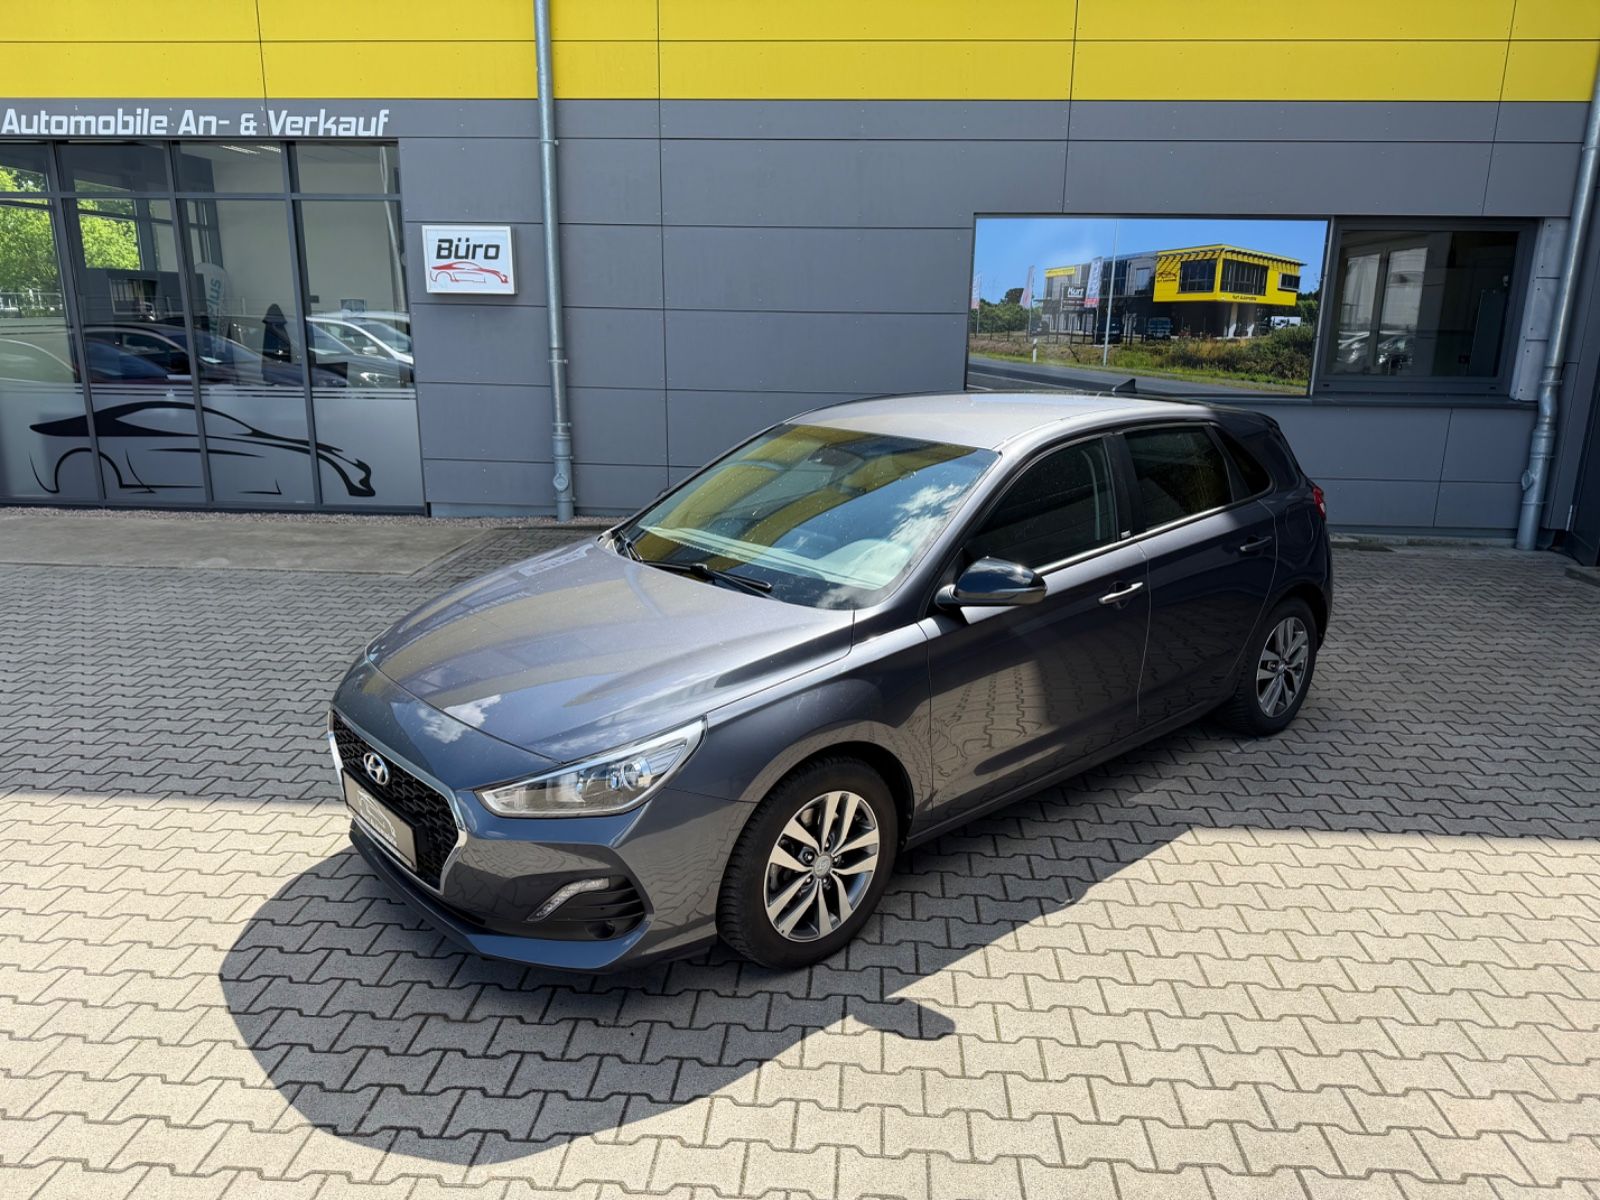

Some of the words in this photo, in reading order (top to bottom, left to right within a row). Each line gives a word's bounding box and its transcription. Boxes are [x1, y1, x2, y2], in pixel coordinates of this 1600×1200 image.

[1, 108, 168, 135] Automobile
[178, 109, 230, 135] An-
[240, 113, 257, 134] &
[268, 110, 389, 137] Verkauf
[436, 237, 500, 260] Büro
